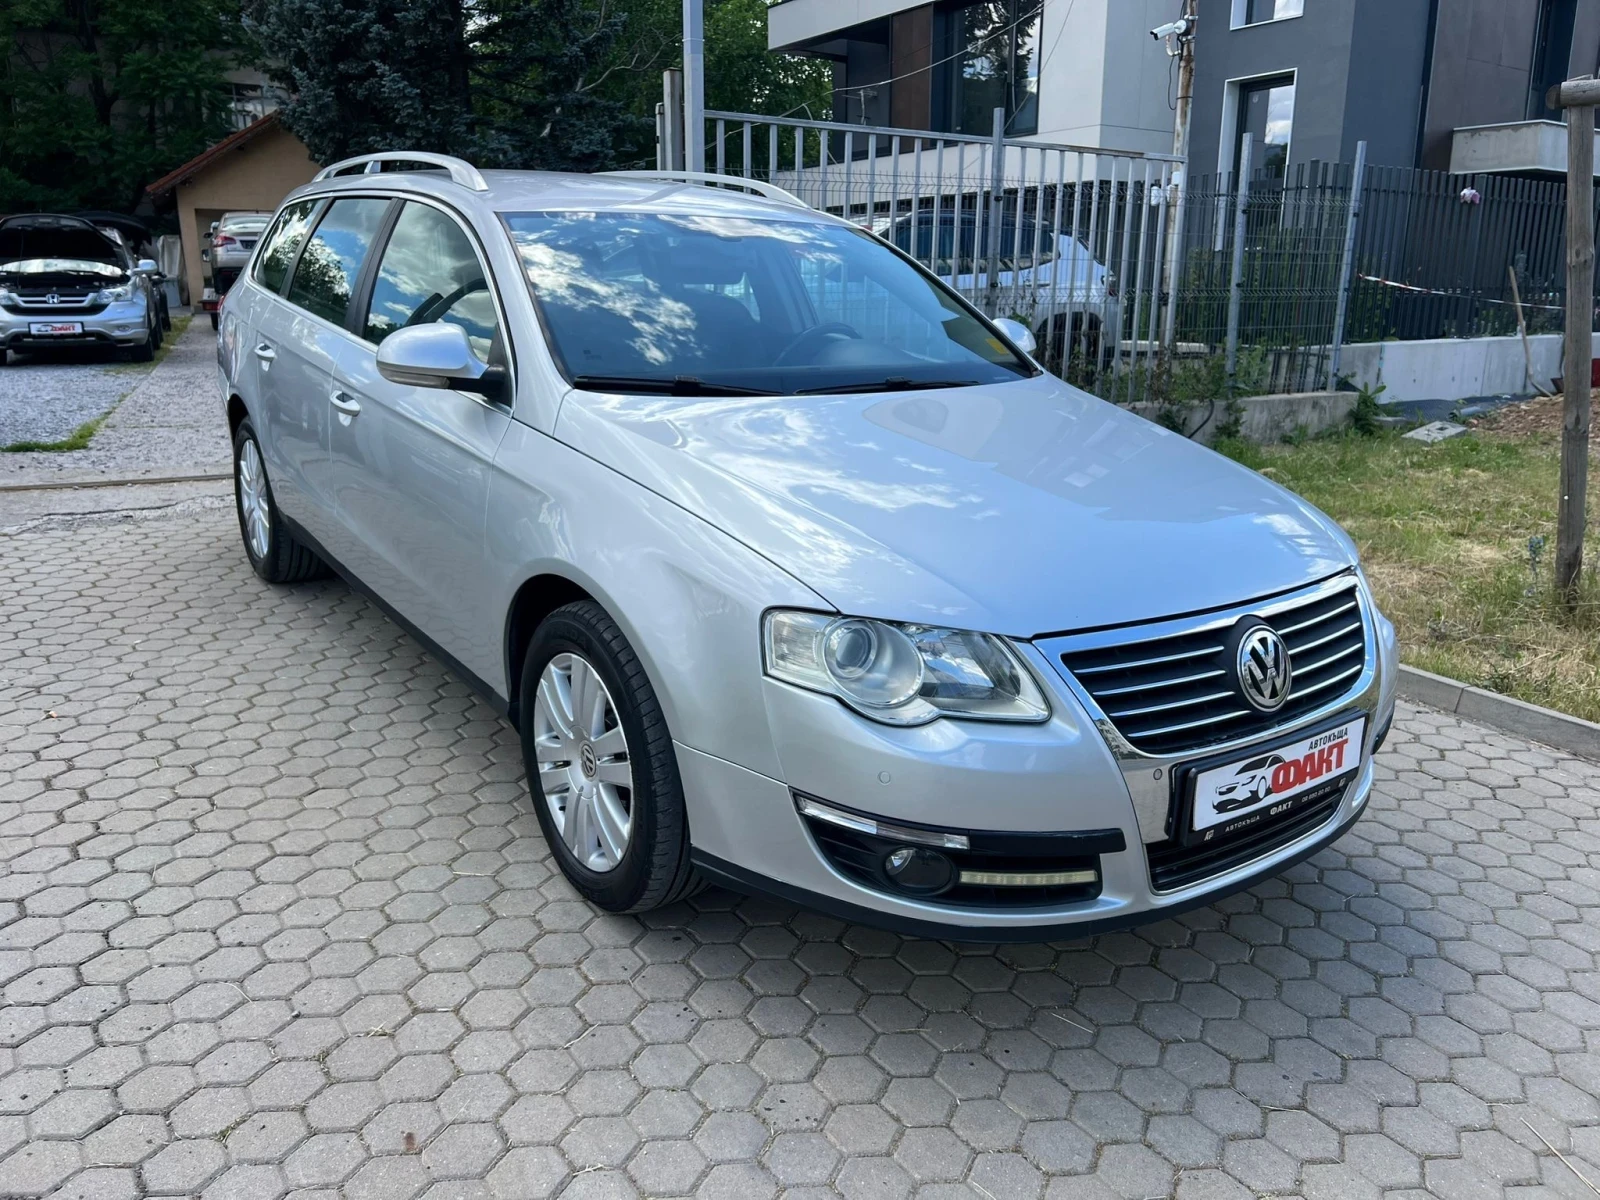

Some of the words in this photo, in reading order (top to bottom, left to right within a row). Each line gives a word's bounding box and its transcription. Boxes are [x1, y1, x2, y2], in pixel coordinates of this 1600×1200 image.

[1308, 727, 1348, 751] АВТОКЪЩА
[1271, 738, 1349, 794] ФАКТ
[1270, 801, 1293, 815] ФАКТ
